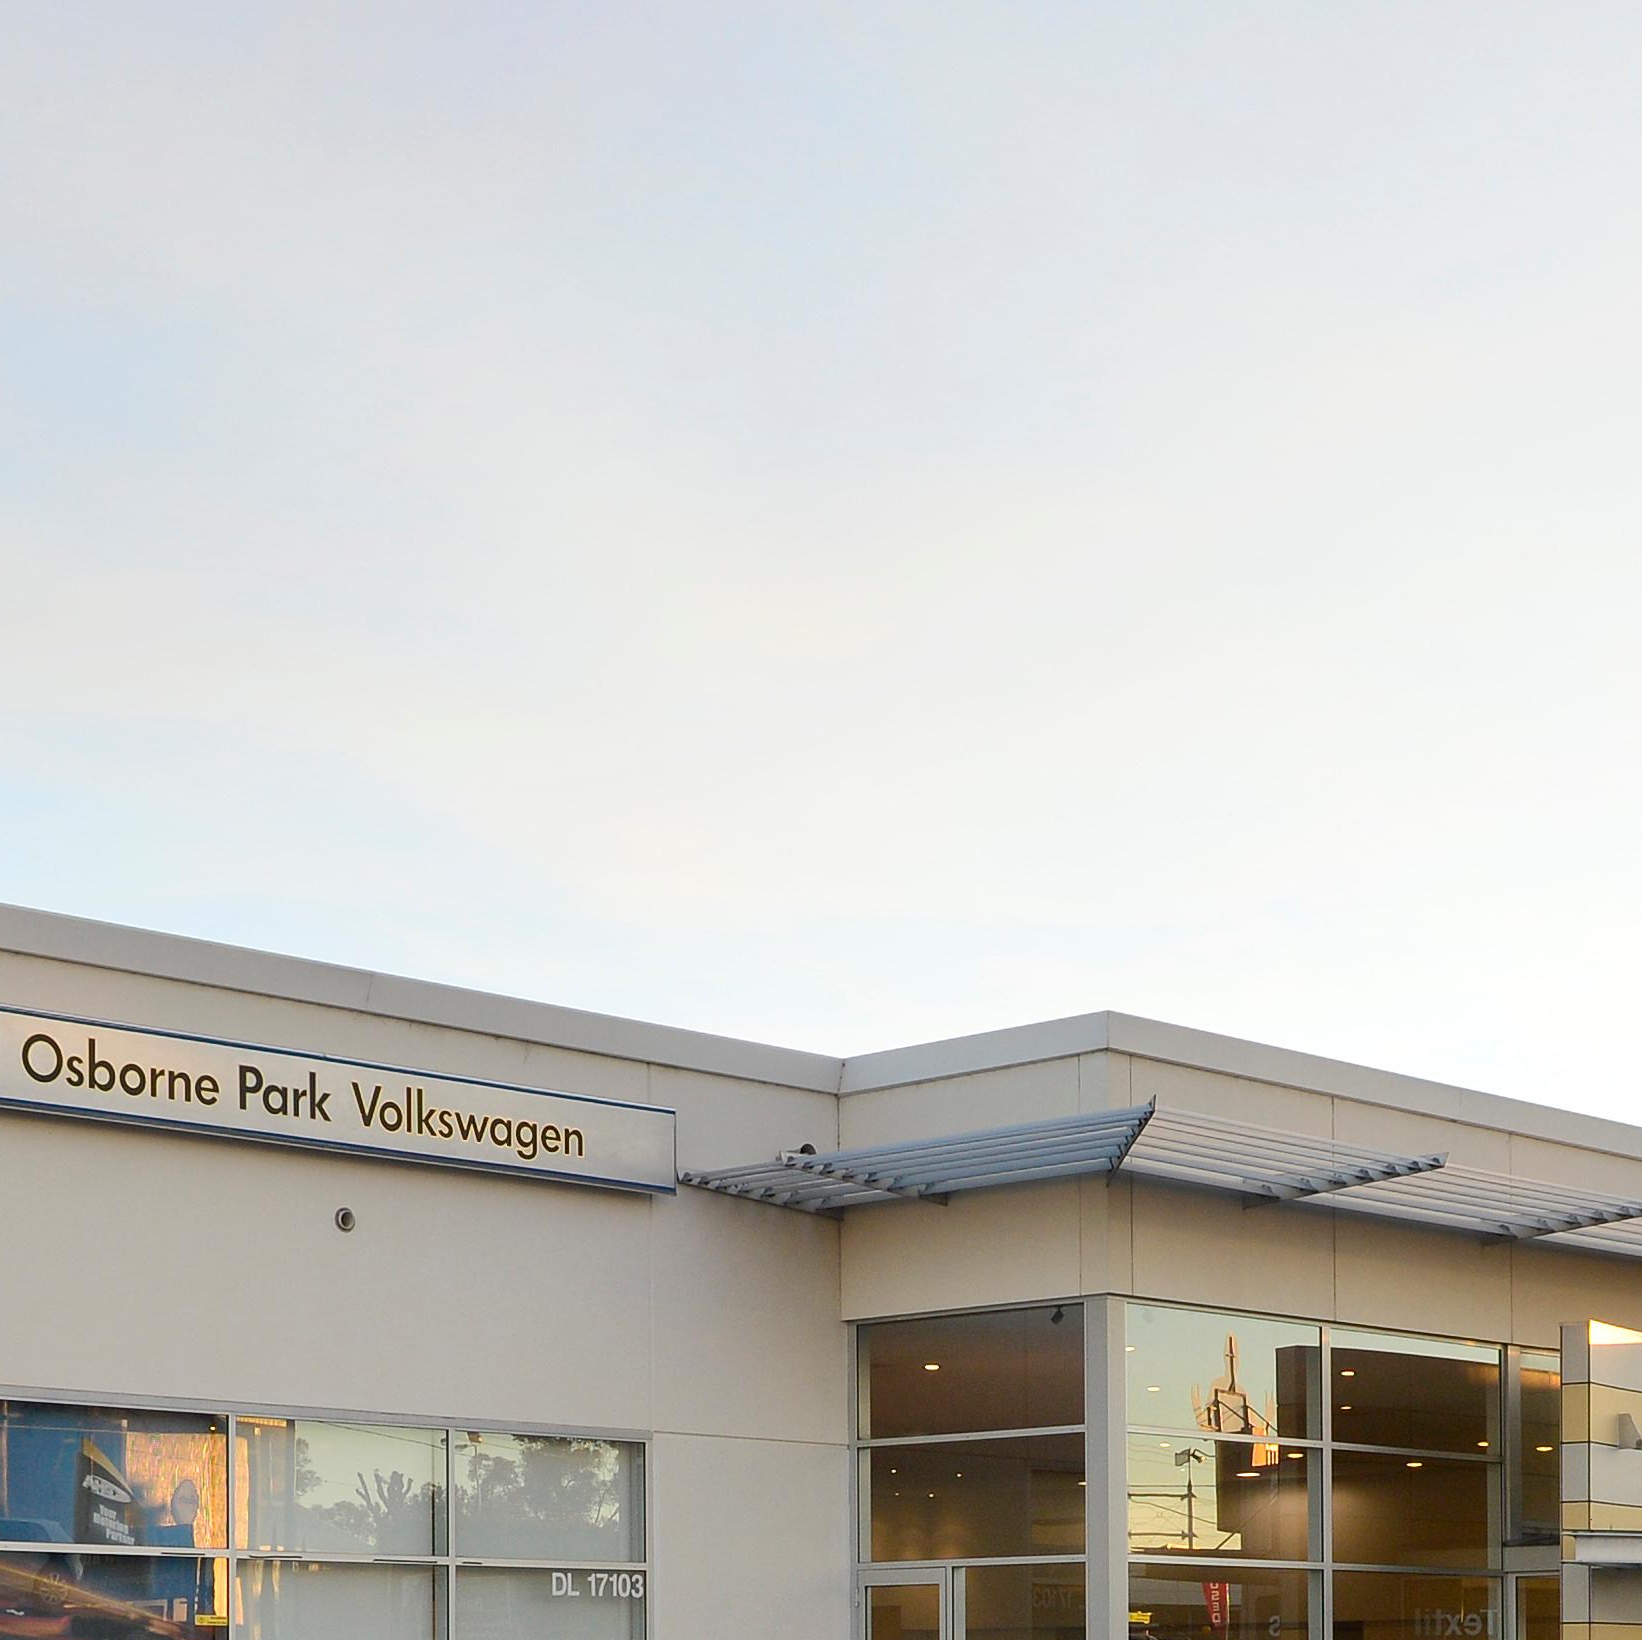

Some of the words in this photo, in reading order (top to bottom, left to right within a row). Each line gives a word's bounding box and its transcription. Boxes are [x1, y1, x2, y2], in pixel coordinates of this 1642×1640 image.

[21, 1033, 220, 1105] Osborne
[238, 1064, 332, 1122] Park
[351, 1081, 585, 1160] Volkswagen
[552, 1572, 581, 1597] DL
[587, 1573, 644, 1598] 17103
